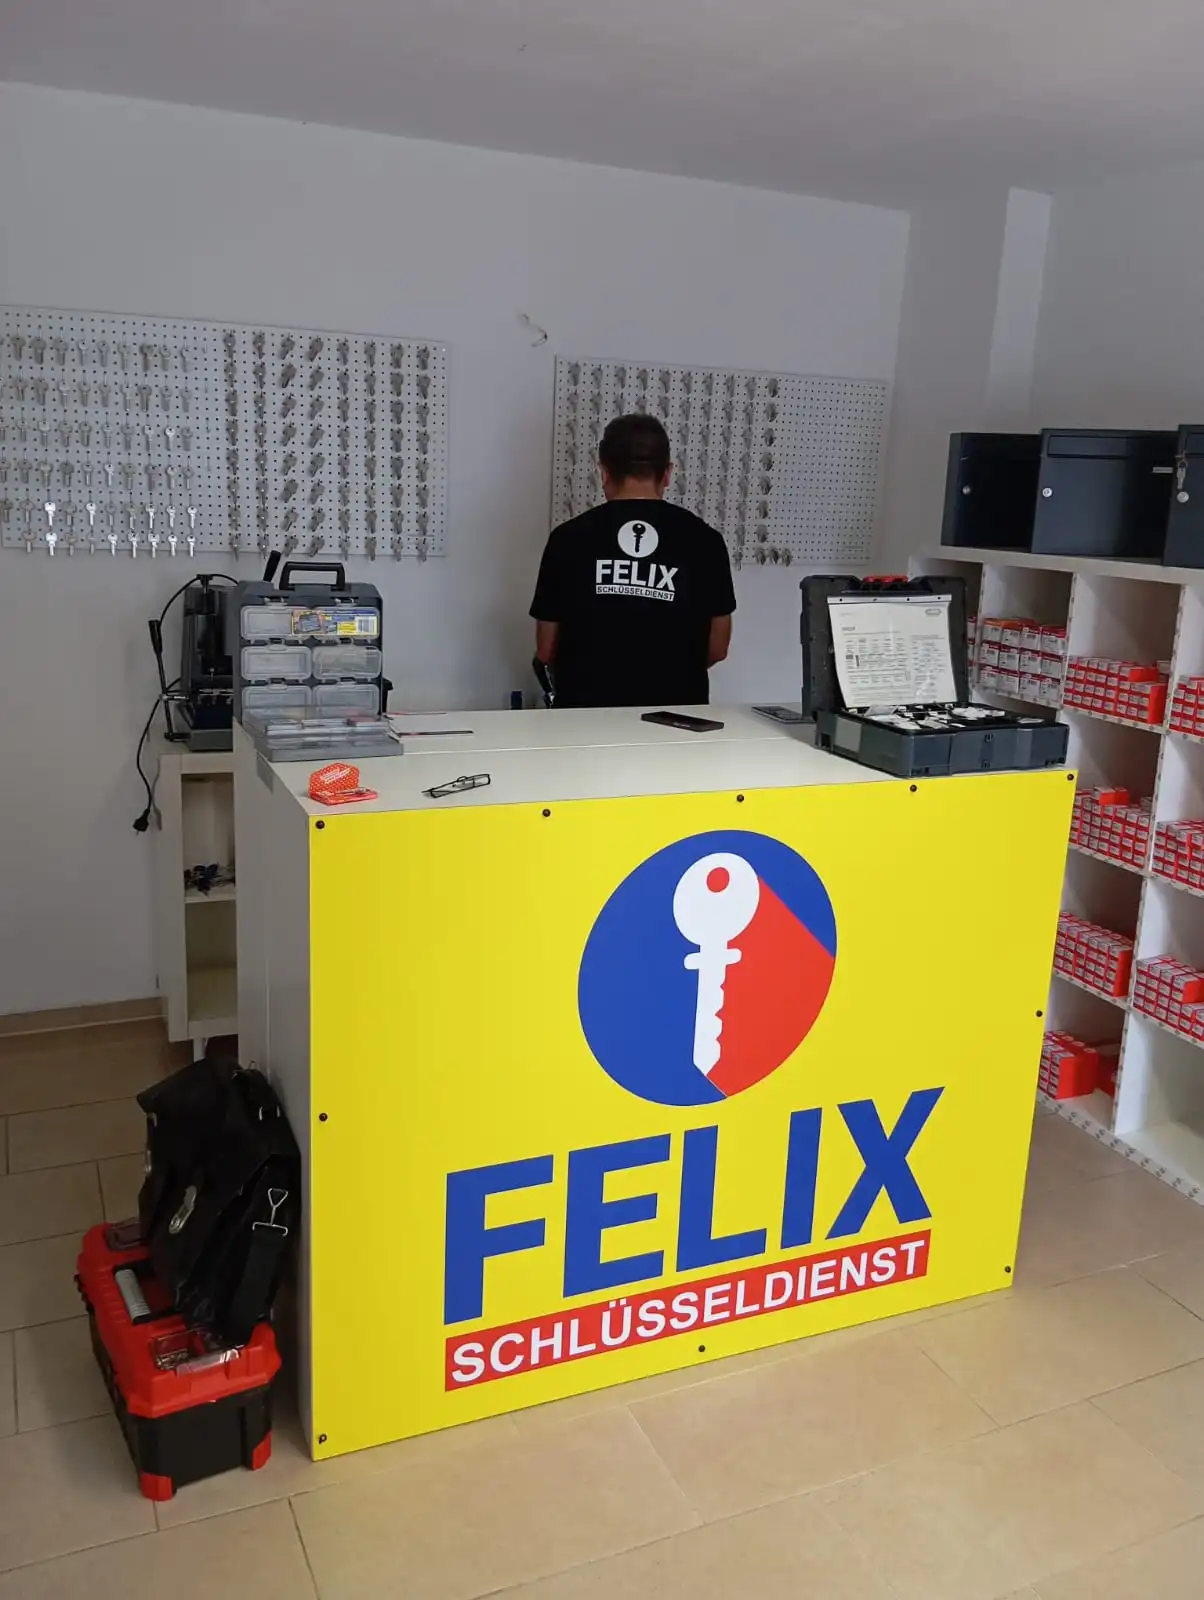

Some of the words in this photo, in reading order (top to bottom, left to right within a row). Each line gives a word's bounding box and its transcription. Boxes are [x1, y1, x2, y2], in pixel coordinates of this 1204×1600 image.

[596, 559, 678, 591] FELIX
[596, 585, 674, 601] SCHLÜSSELDIENST
[444, 1086, 945, 1325] FELIX
[450, 1239, 926, 1382] SCHLÜSSELDIENST
